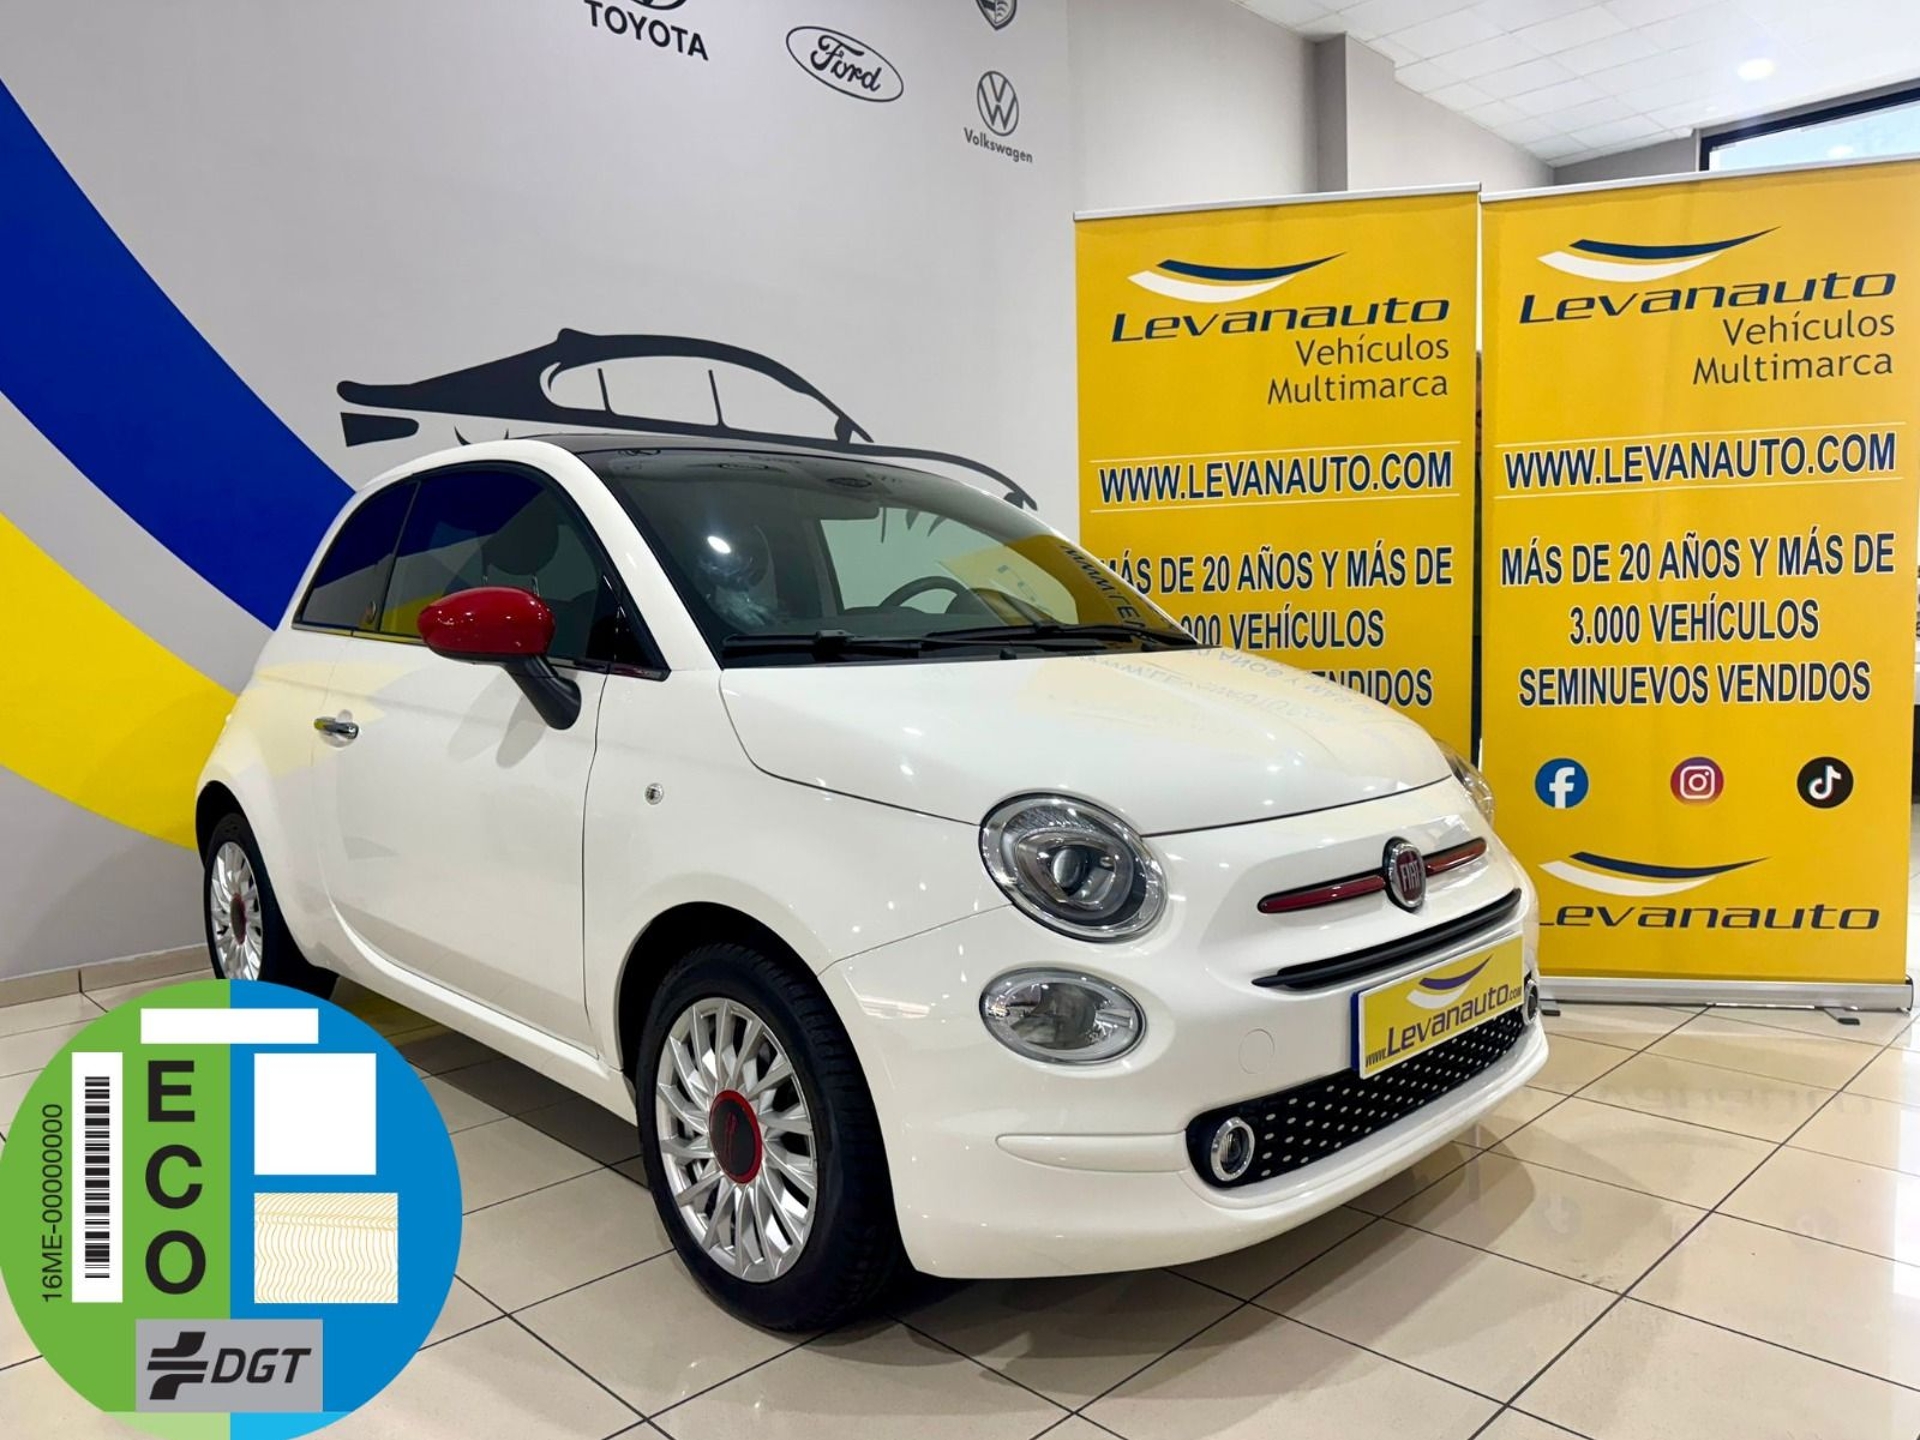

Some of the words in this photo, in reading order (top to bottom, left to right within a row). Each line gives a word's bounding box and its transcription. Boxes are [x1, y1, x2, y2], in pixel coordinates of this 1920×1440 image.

[583, 0, 709, 61] TOYOTA
[810, 35, 882, 92] Ford
[963, 127, 1033, 163] Volkswagen
[1111, 297, 1450, 342] Levanauto
[1519, 272, 1896, 325] Levanauto
[1295, 333, 1449, 367] Vehículos
[1722, 309, 1895, 346] Vehículos
[1267, 374, 1448, 405] Multimarca
[1692, 353, 1893, 385] Multimarca
[1099, 451, 1451, 503] WWW.LEVANAUTO.COM
[1504, 432, 1895, 489] WWW.LEVANAUTO.COM
[1161, 556, 1194, 594] DE
[1202, 555, 1230, 592] 20
[1237, 546, 1313, 591] AÑOS
[1321, 551, 1339, 588] Y
[1347, 540, 1406, 588] MÁS
[1416, 547, 1452, 585] DE
[1502, 537, 1562, 586] MÁS
[1573, 544, 1610, 583] DE
[1619, 542, 1651, 581] 20
[1659, 532, 1740, 580] AÑOS
[1749, 537, 1769, 577] Y
[1778, 526, 1843, 576] MÁS
[1854, 533, 1895, 573] DE
[1229, 603, 1384, 650] VEHÍCULOS
[1570, 605, 1640, 645] 3.000
[1649, 592, 1819, 642] VEHÍCULOS
[1519, 665, 1708, 707] SEMINUEVOS
[1717, 661, 1870, 703] VENDIDOS
[1400, 860, 1420, 892] FIAT
